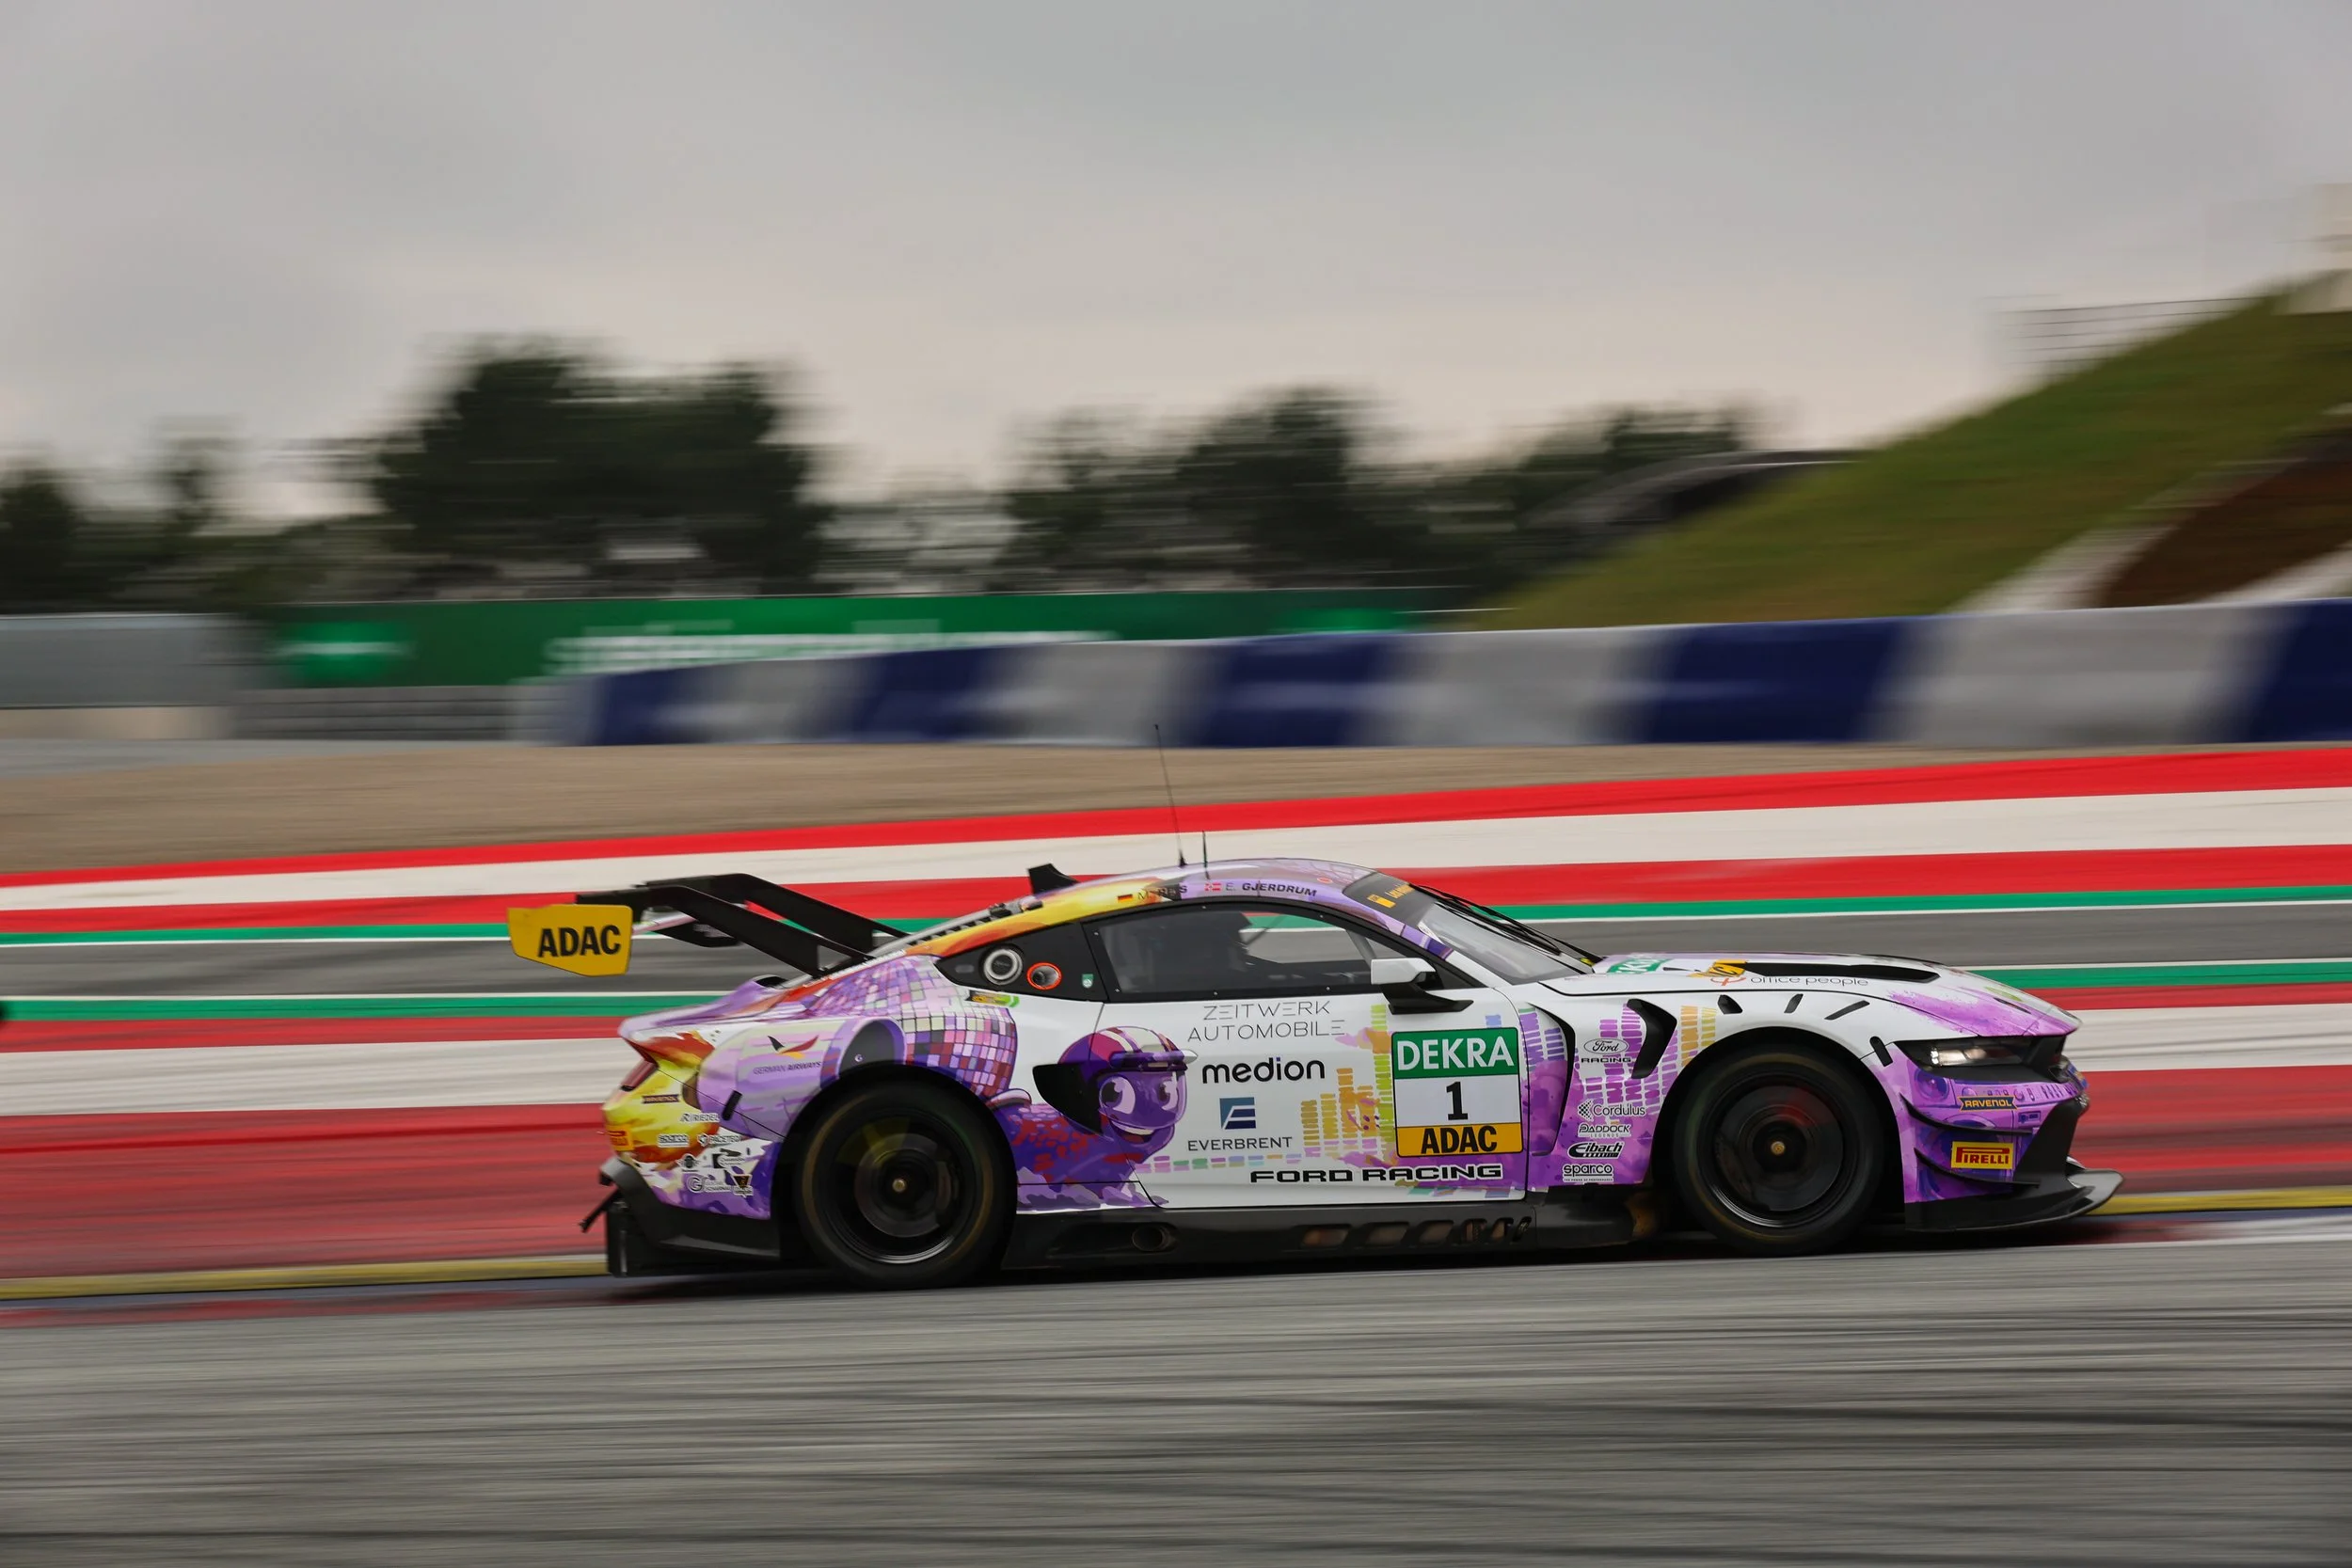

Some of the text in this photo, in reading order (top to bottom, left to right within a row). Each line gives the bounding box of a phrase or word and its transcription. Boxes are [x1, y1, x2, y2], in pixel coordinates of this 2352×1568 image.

[1241, 881, 1317, 897] GJERDRUM
[537, 925, 622, 958] ADAC
[1805, 977, 1868, 987] people
[1203, 1000, 1330, 1021] ZEITWERK
[1187, 1020, 1345, 1042] AUTOMOBILE
[1397, 1036, 1515, 1070] DEKRA
[1592, 1040, 1620, 1053] Ford
[1202, 1056, 1326, 1084] medion
[1446, 1081, 1469, 1120] 1
[1964, 1099, 2012, 1108] RAVENOL
[1593, 1103, 1645, 1117] Cordulus
[1579, 1123, 1630, 1133] PADDOCK
[1187, 1136, 1293, 1151] EVERBRENT
[1421, 1125, 1498, 1154] ADAC
[1568, 1142, 1624, 1158] Eibach
[1956, 1147, 2010, 1164] PIRELLI
[1250, 1164, 1503, 1183] FORD RACING
[1563, 1164, 1613, 1177] sparco
